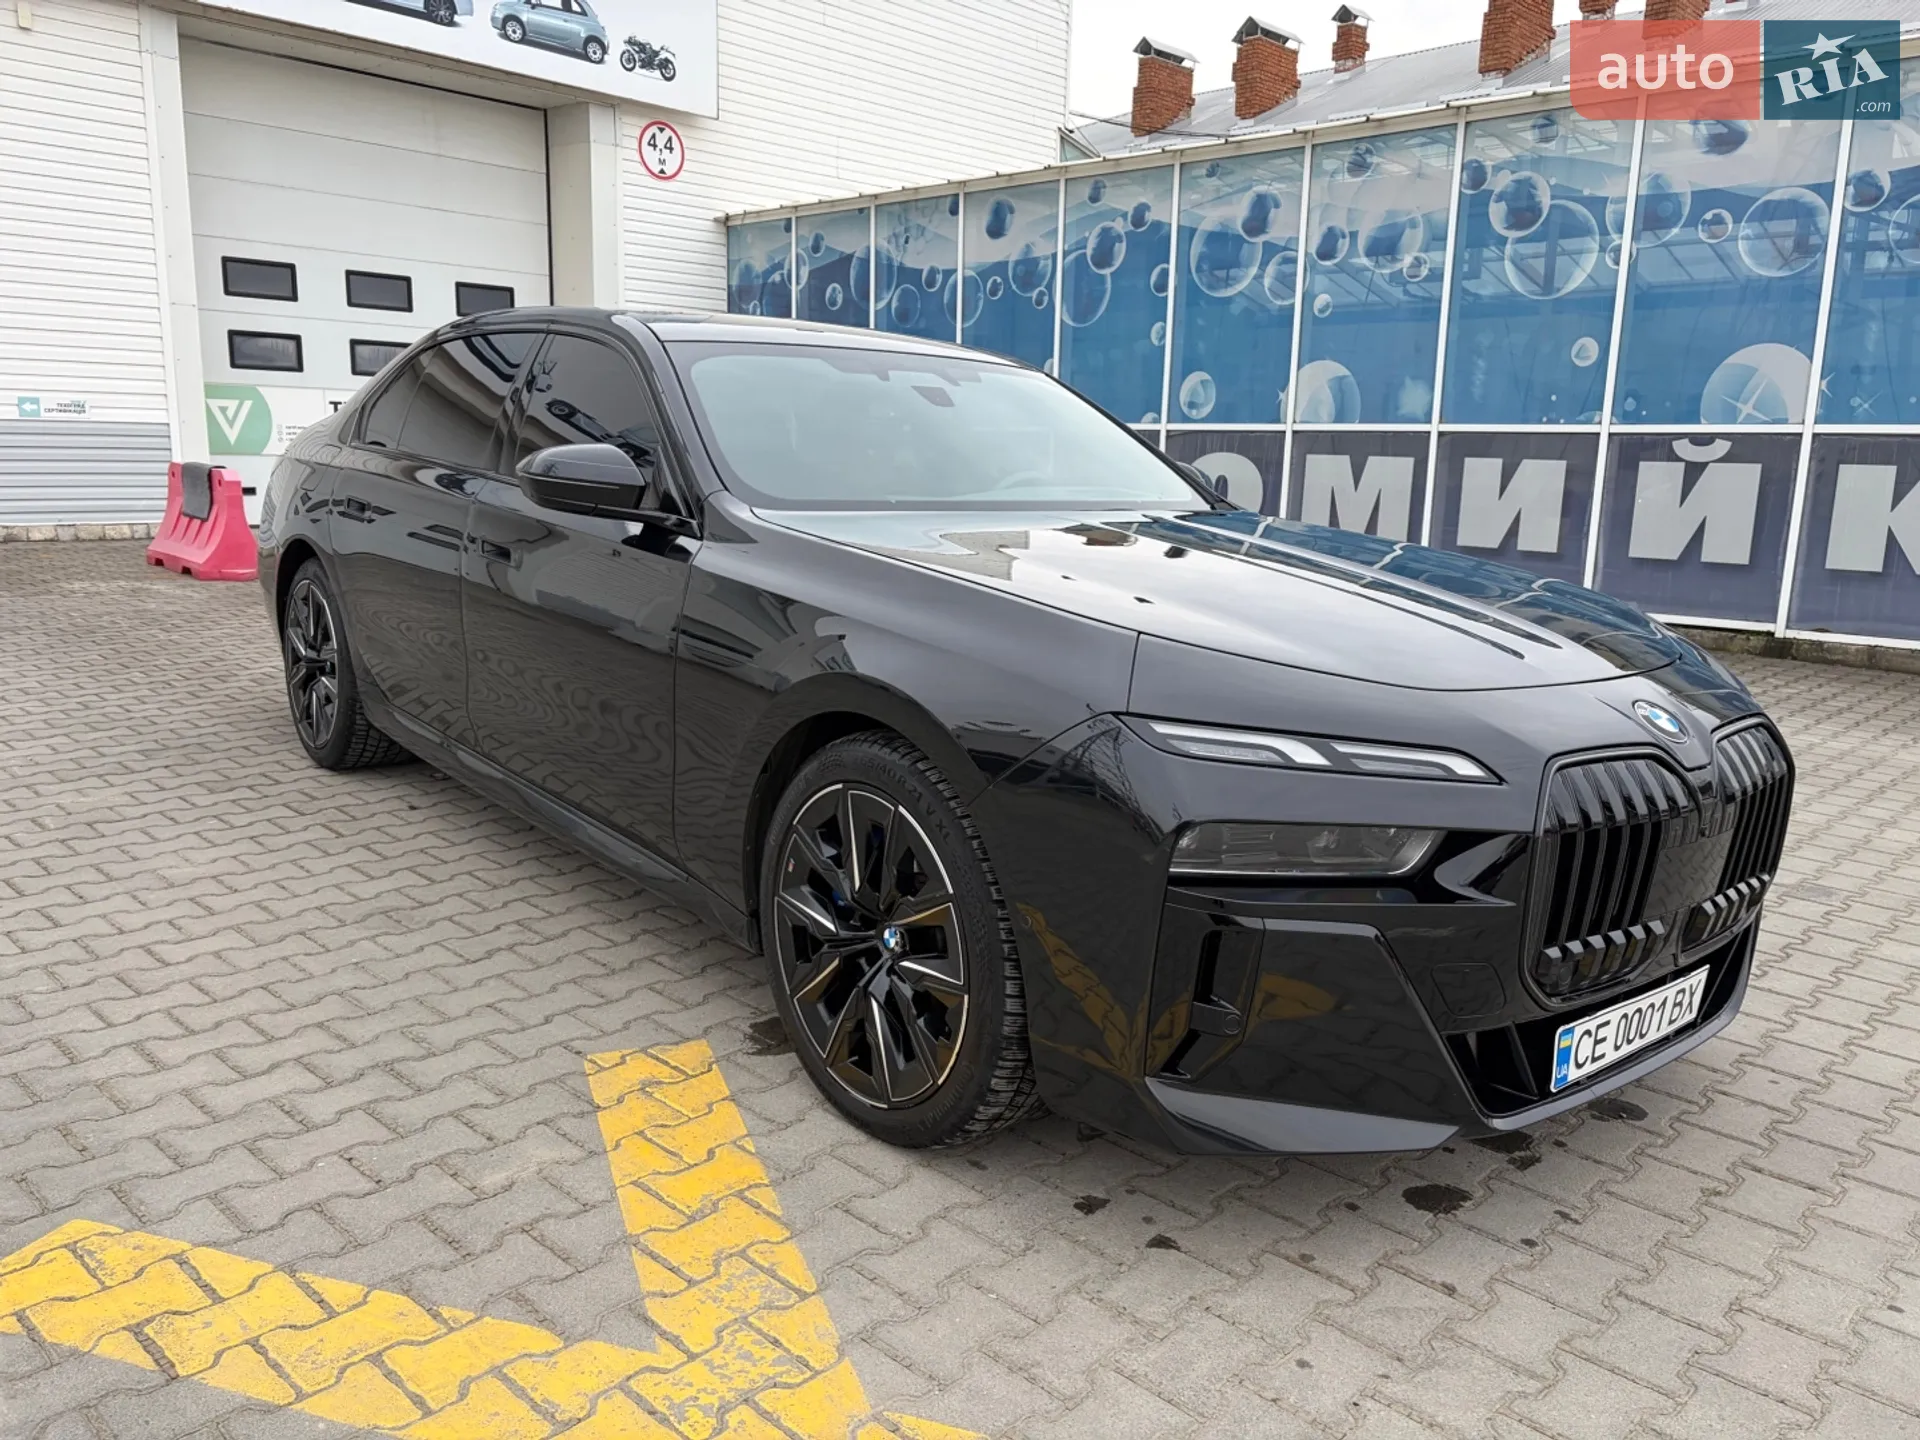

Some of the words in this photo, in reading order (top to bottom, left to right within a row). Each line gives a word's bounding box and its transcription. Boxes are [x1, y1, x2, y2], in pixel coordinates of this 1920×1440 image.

[647, 132, 675, 156] 4,4
[1574, 1018, 1612, 1070] CE
[1614, 995, 1669, 1052] 0001
[1668, 978, 1702, 1025] BX
